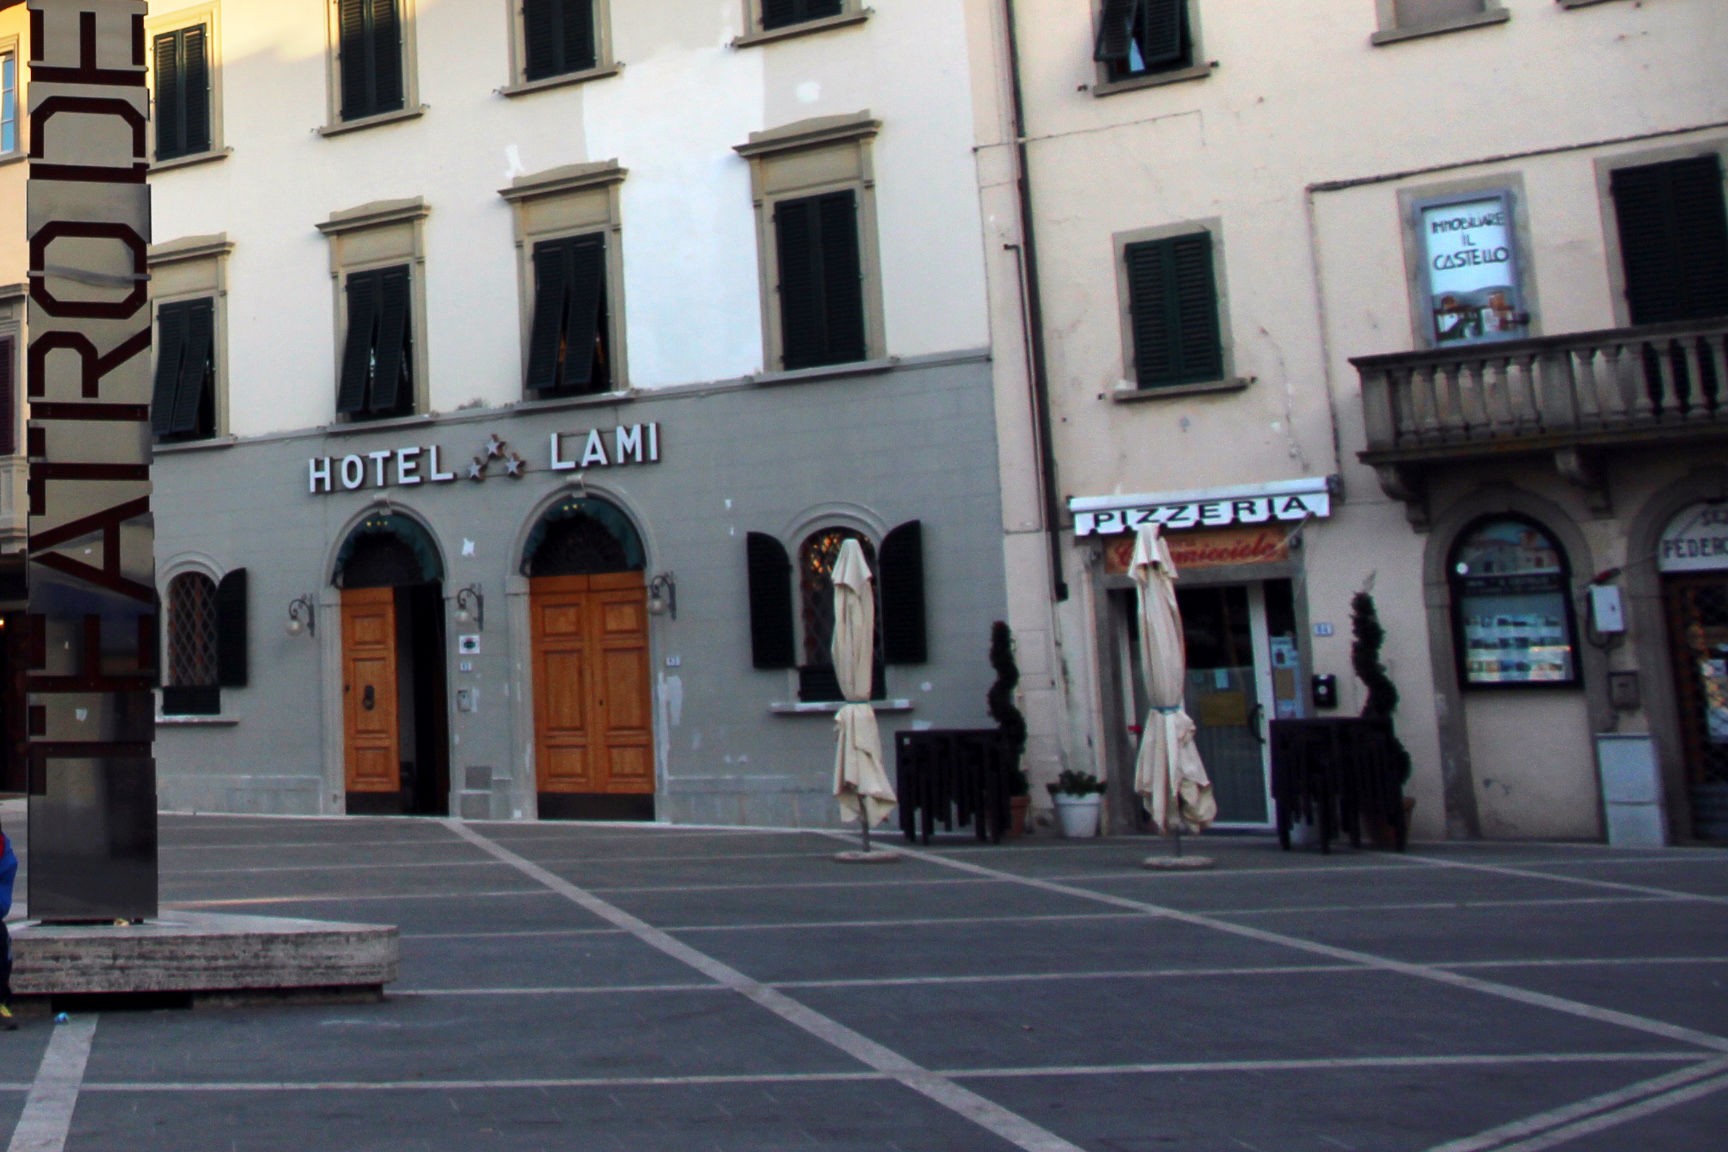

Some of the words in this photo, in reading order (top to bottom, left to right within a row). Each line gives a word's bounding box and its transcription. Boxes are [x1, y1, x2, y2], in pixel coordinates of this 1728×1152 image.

[1462, 234, 1475, 246] IL
[1434, 247, 1510, 270] CASTELLO
[309, 445, 454, 493] HOTEL
[550, 422, 660, 470] LAMI
[29, 220, 152, 796] TEATRO
[1093, 496, 1310, 528] PIZZERIA
